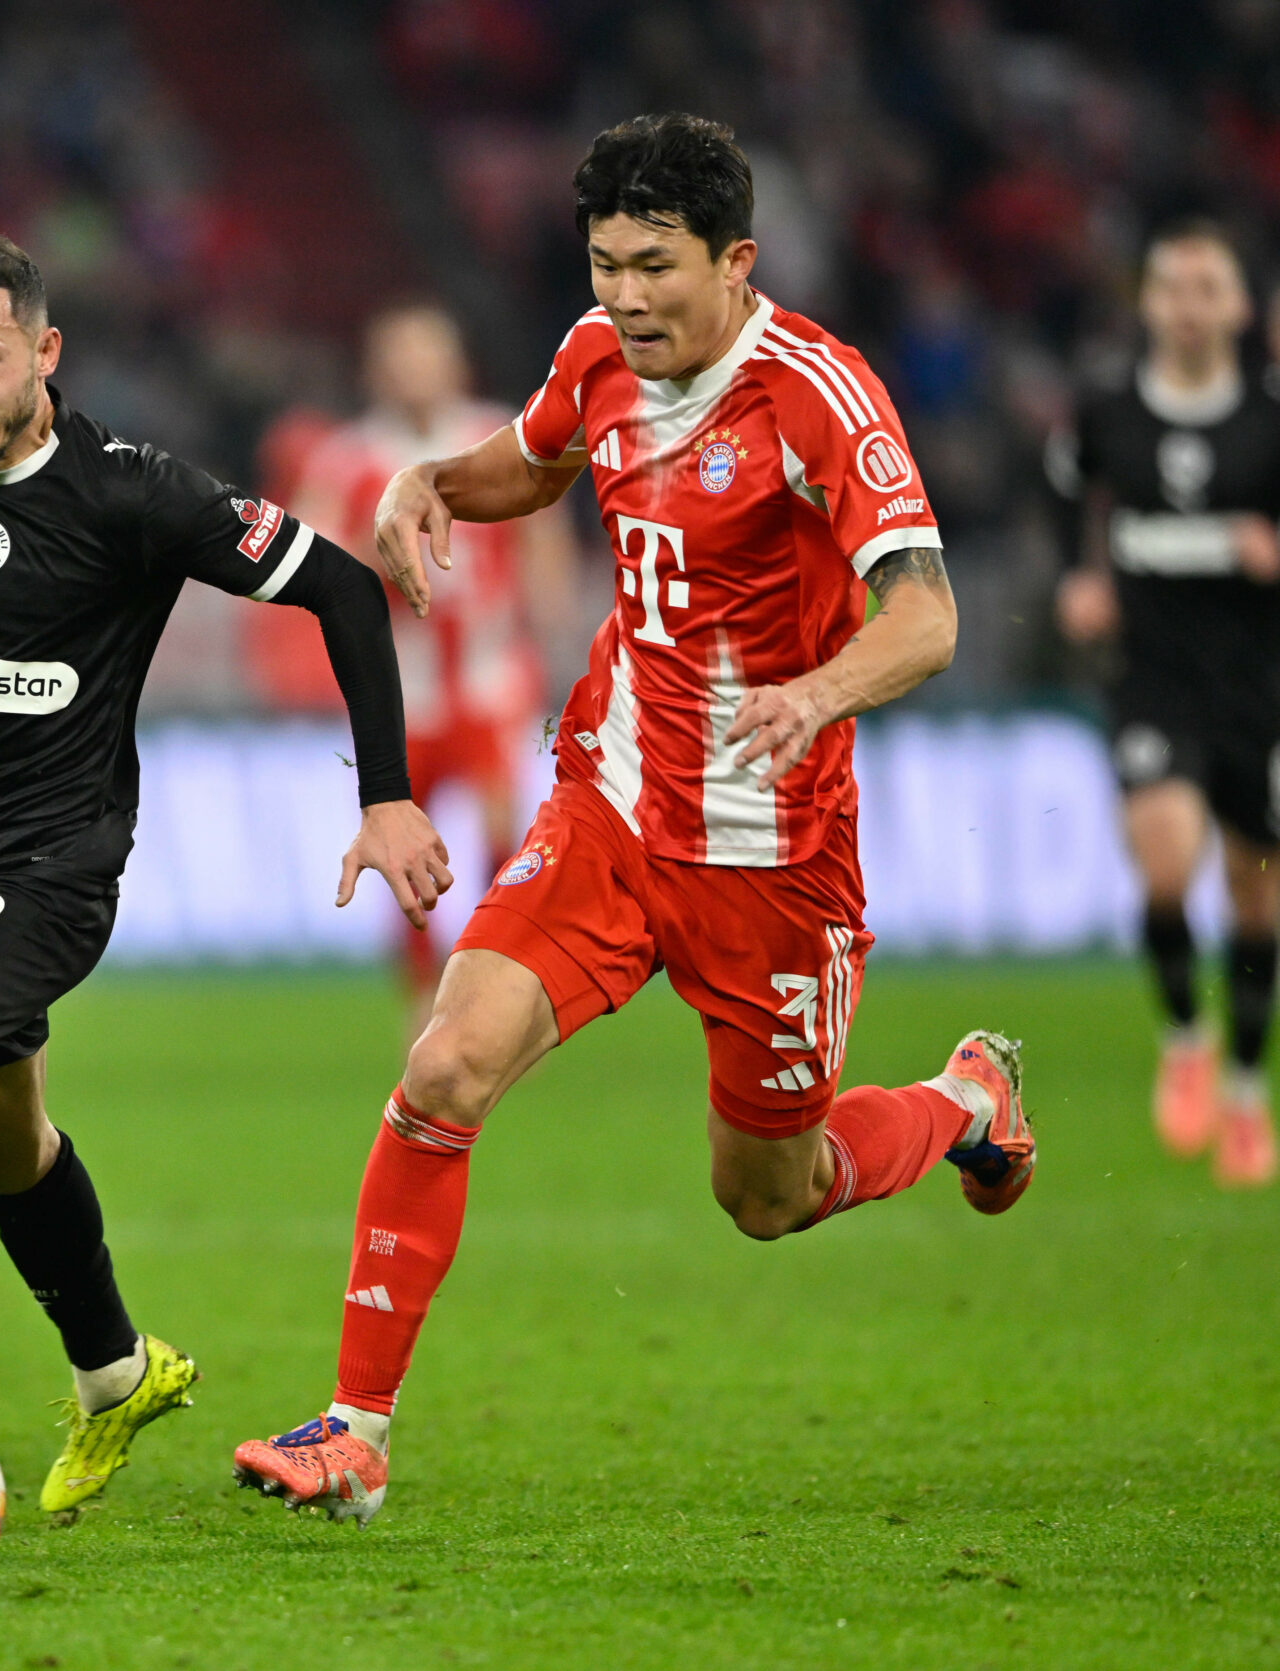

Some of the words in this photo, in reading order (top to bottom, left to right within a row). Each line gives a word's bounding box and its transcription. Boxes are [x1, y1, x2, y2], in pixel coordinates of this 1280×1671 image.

[704, 451, 713, 463] FC
[713, 446, 734, 467] BAYERN
[877, 496, 924, 526] Allianz
[248, 504, 280, 554] ASTRA
[616, 513, 689, 647] T
[771, 973, 818, 1051] 3
[370, 1236, 397, 1249] SAN
[371, 1228, 397, 1241] MIA
[368, 1244, 394, 1256] MIA
